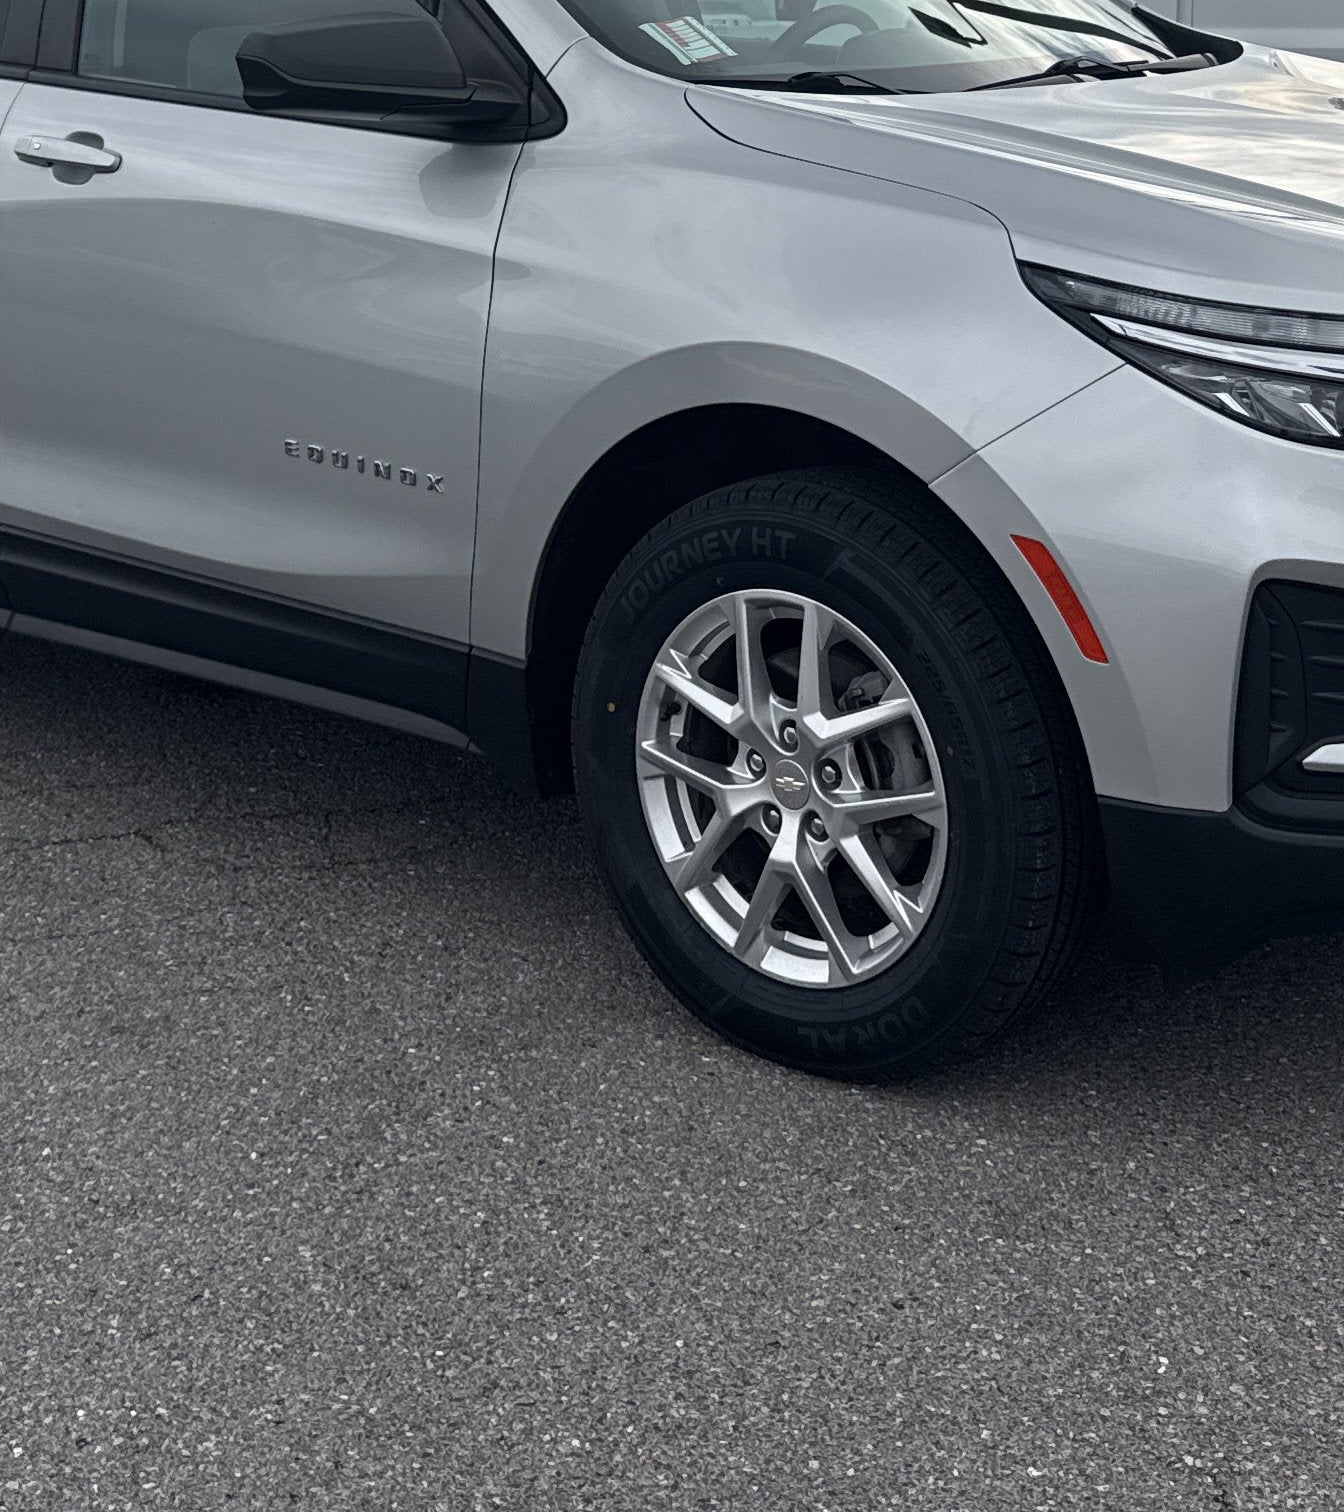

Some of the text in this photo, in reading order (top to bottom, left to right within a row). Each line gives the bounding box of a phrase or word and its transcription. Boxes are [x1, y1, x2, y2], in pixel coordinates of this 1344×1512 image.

[284, 438, 445, 494] EQUINOX
[618, 526, 796, 620] JOURNEY HT
